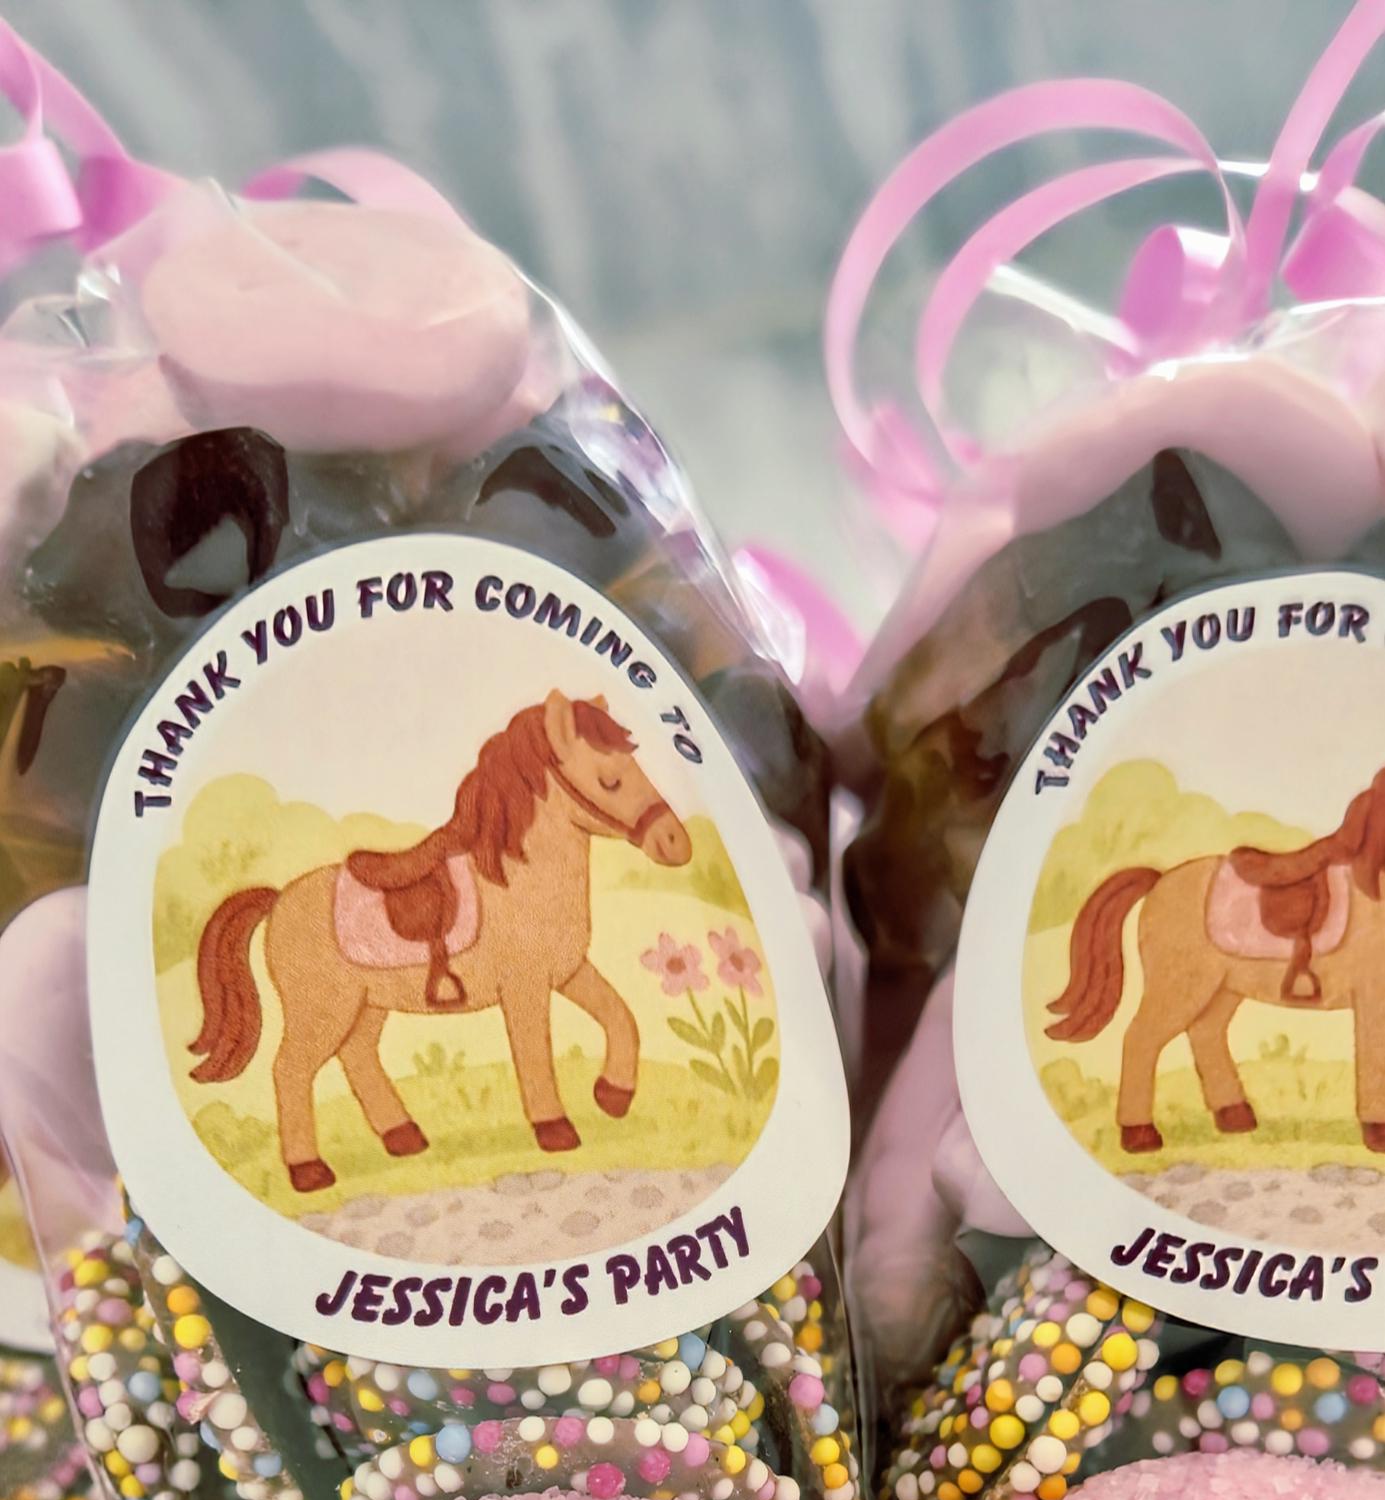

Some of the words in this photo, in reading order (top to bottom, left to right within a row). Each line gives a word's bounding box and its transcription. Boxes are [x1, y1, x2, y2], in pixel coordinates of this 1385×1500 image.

[134, 650, 241, 817] THANK
[241, 589, 334, 665] YOU
[356, 570, 454, 618] FOR
[475, 575, 657, 689] COMING
[660, 705, 703, 764] TO
[1035, 642, 1152, 795] THANK
[1161, 606, 1256, 661] YOU
[1278, 601, 1370, 643] FOR
[316, 1264, 589, 1326] JESSICA'S
[606, 1206, 750, 1304] PARTY
[1109, 1228, 1379, 1303] JESSICA'S
